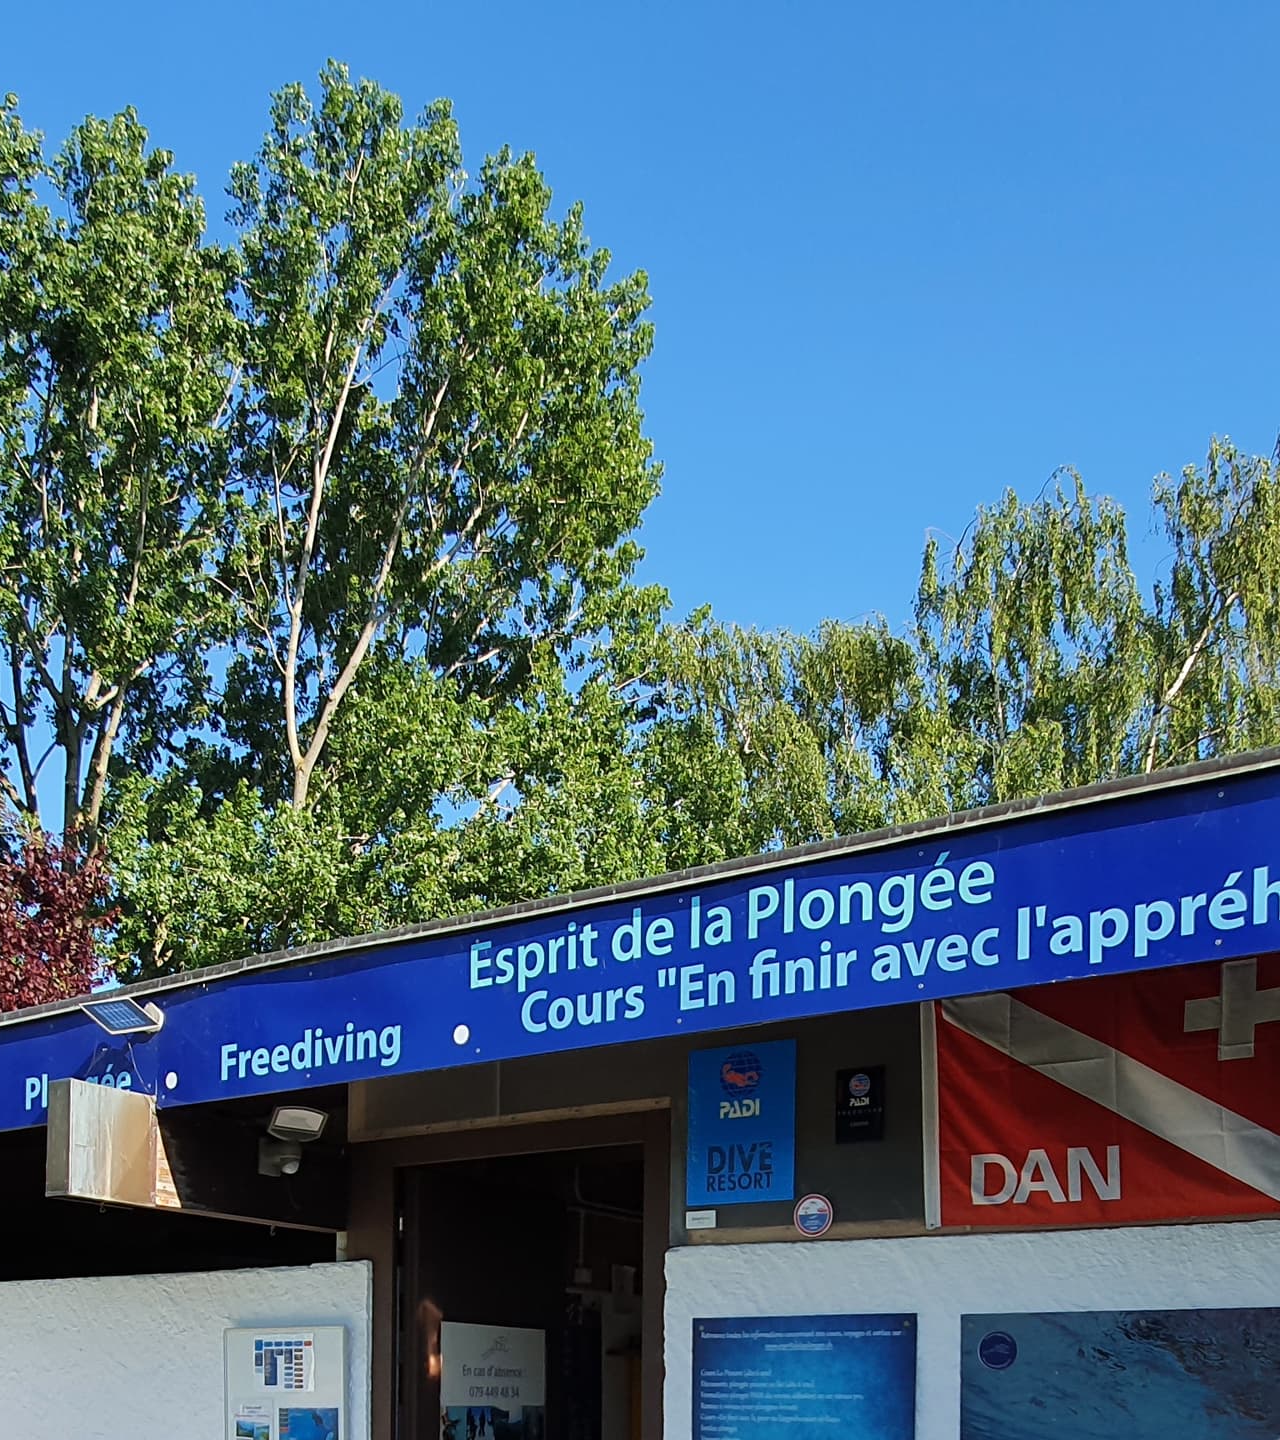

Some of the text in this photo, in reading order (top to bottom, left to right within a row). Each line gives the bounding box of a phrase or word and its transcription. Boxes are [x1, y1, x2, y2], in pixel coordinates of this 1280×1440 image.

[470, 851, 995, 989] Esprit de la Plongée
[517, 985, 645, 1034] Cours
[657, 964, 736, 1013] "En
[748, 941, 858, 1001] finir
[871, 927, 1000, 982] avec
[220, 1022, 402, 1081] Freediving
[720, 1098, 760, 1119] PADI
[706, 1171, 773, 1193] RESORT
[707, 1141, 773, 1175] DIVE
[970, 1145, 1121, 1205] DAN
